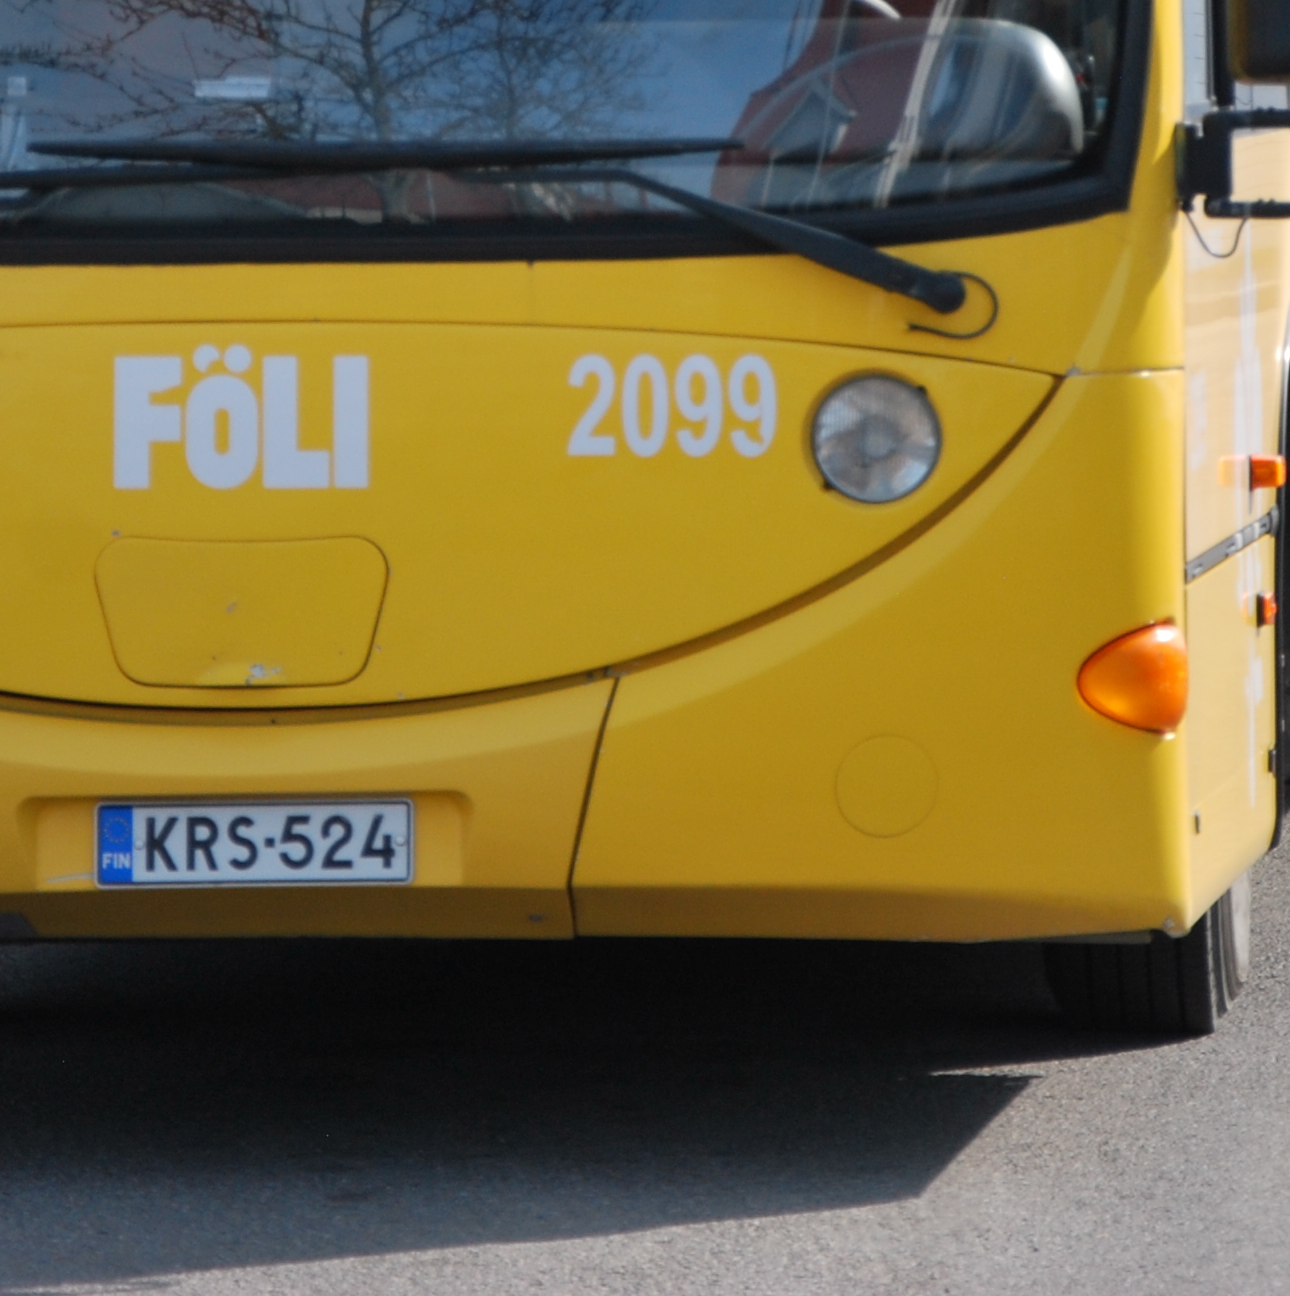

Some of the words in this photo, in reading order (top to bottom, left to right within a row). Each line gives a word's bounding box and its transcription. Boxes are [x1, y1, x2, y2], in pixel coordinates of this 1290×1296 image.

[112, 343, 370, 490] FÖLI
[566, 353, 778, 458] 2099
[101, 851, 132, 870] FIN
[144, 813, 396, 872] KRS-524
